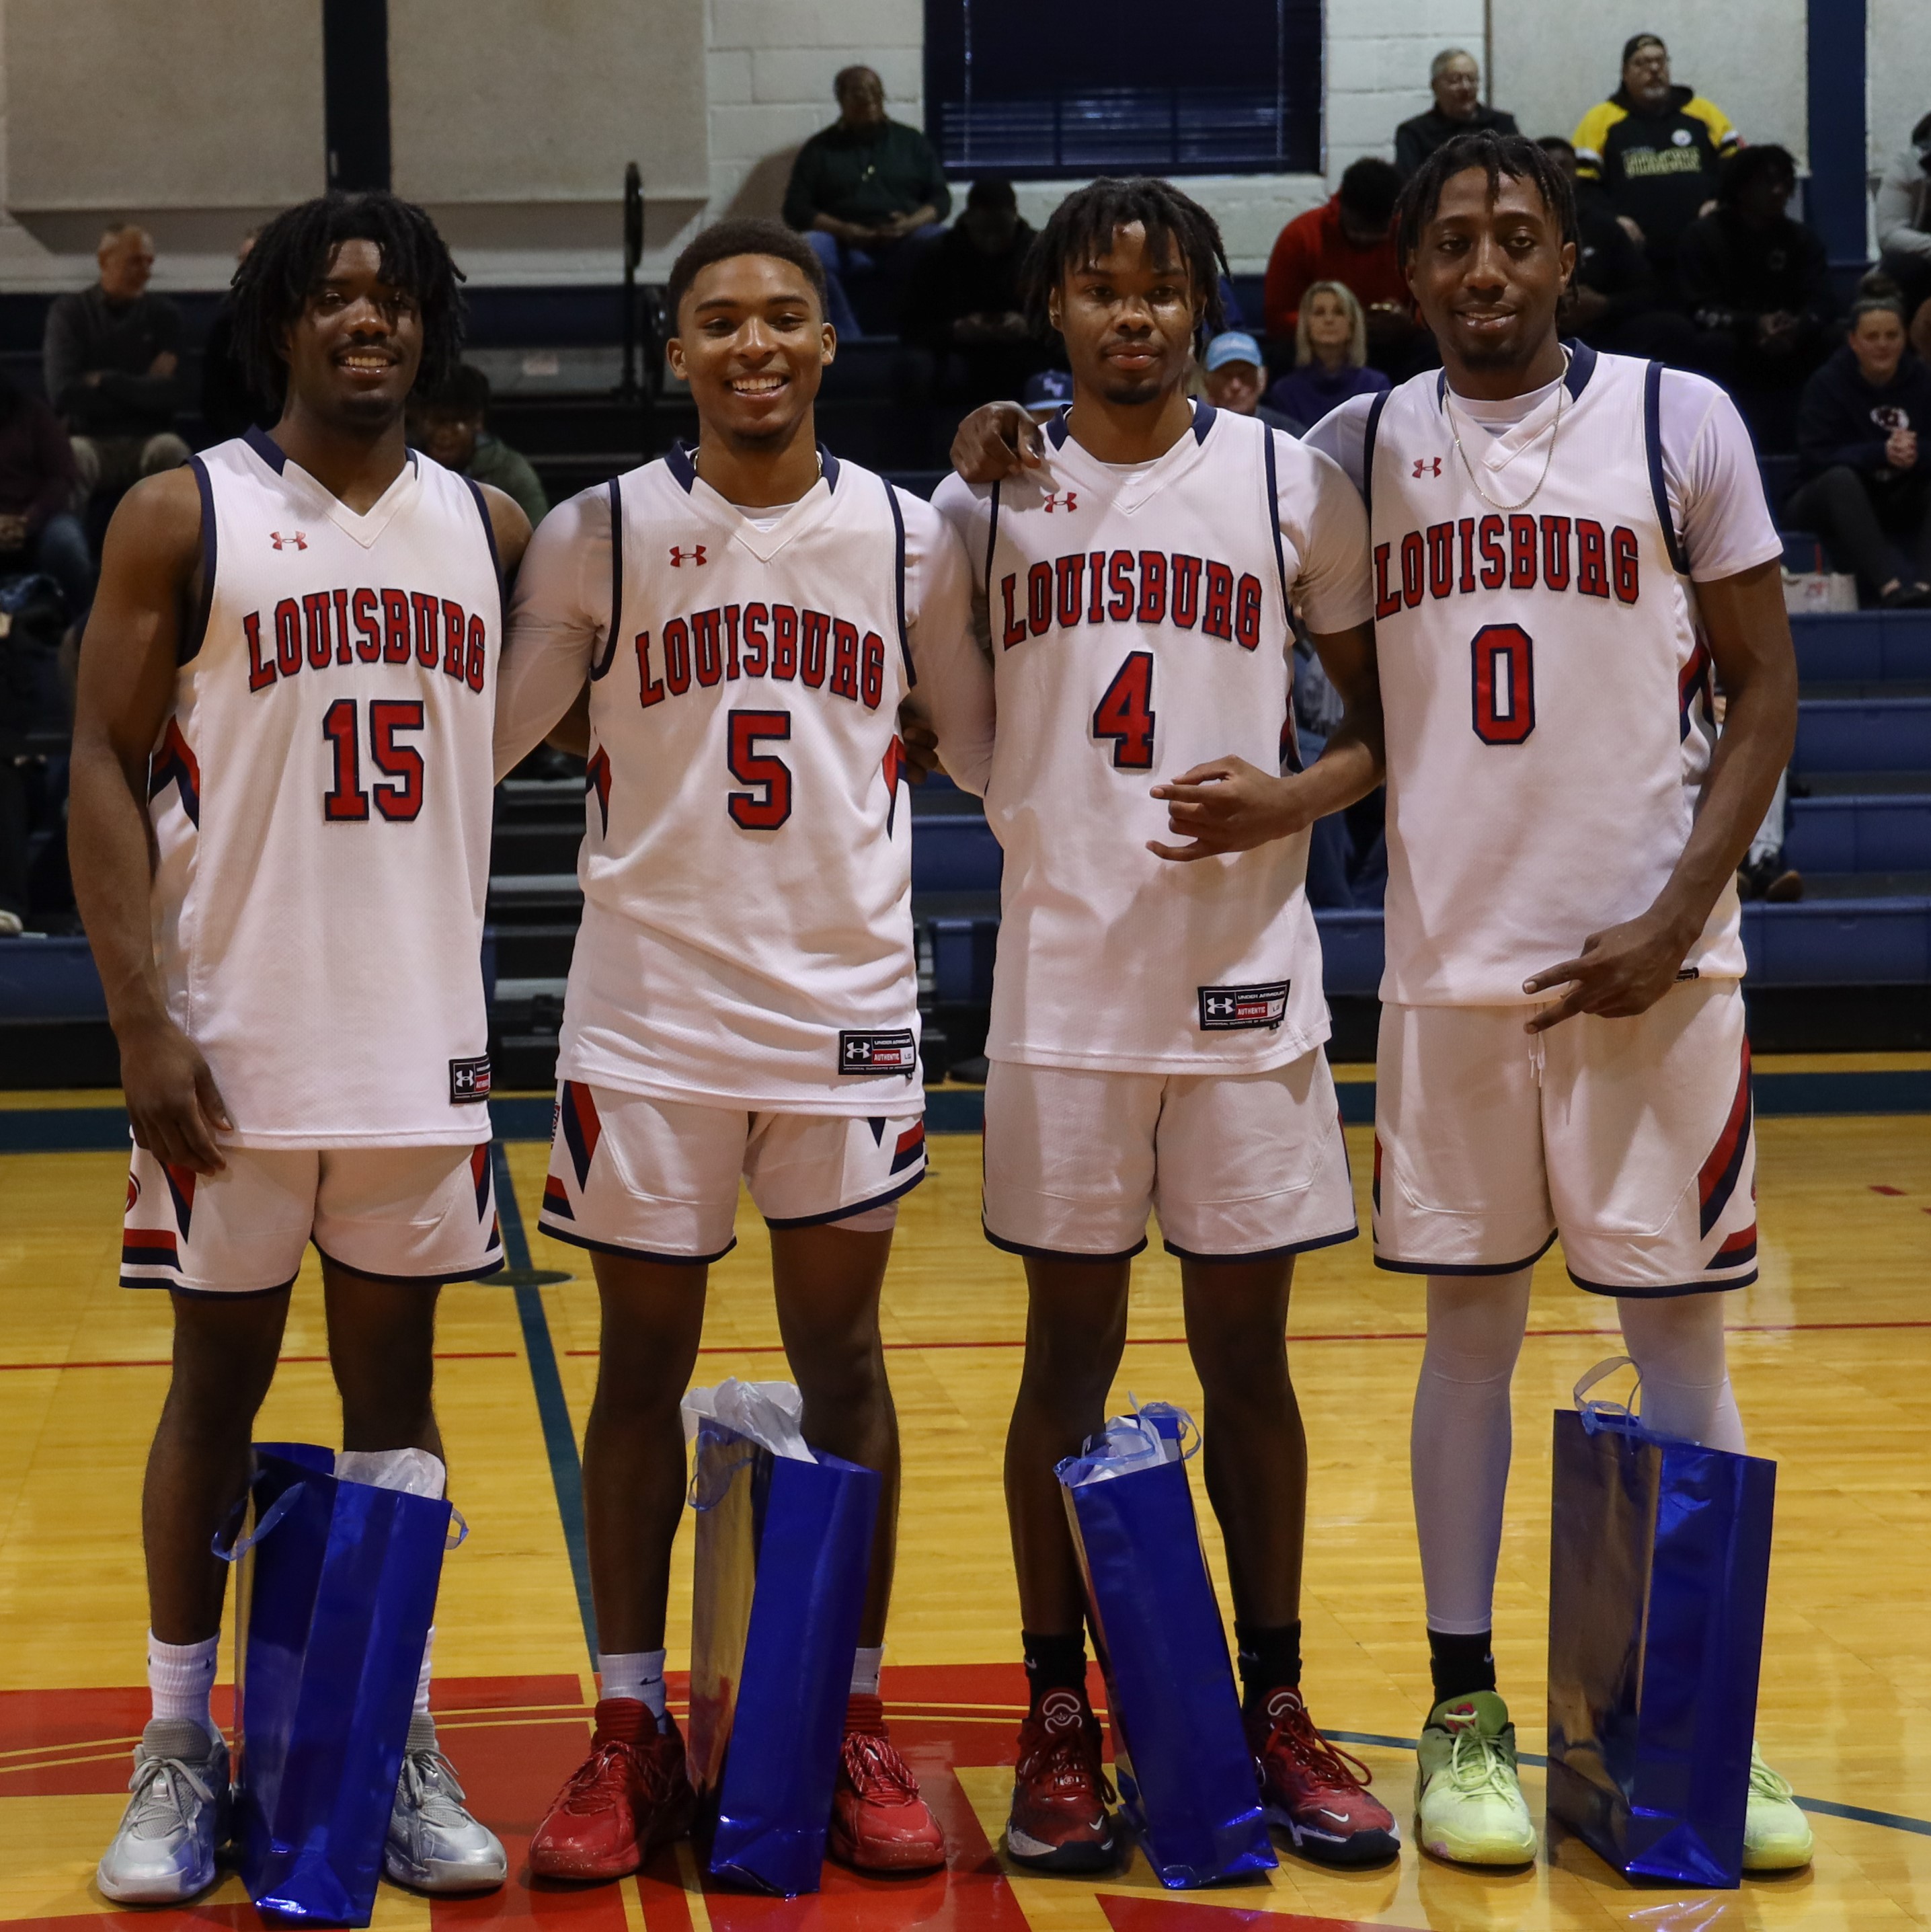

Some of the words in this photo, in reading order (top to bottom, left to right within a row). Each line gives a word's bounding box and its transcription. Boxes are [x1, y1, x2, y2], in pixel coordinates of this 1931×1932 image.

[1000, 549, 1263, 652] LOUISBURG
[1373, 514, 1639, 621] LOUISBURG
[243, 588, 485, 693] LOUISBURG
[635, 602, 885, 710] LOUISBURG
[1470, 623, 1536, 746] 0
[322, 699, 424, 822] 15
[1093, 650, 1156, 769] 4
[727, 709, 792, 831] 5
[1237, 1007, 1265, 1015] AUTHENTIC
